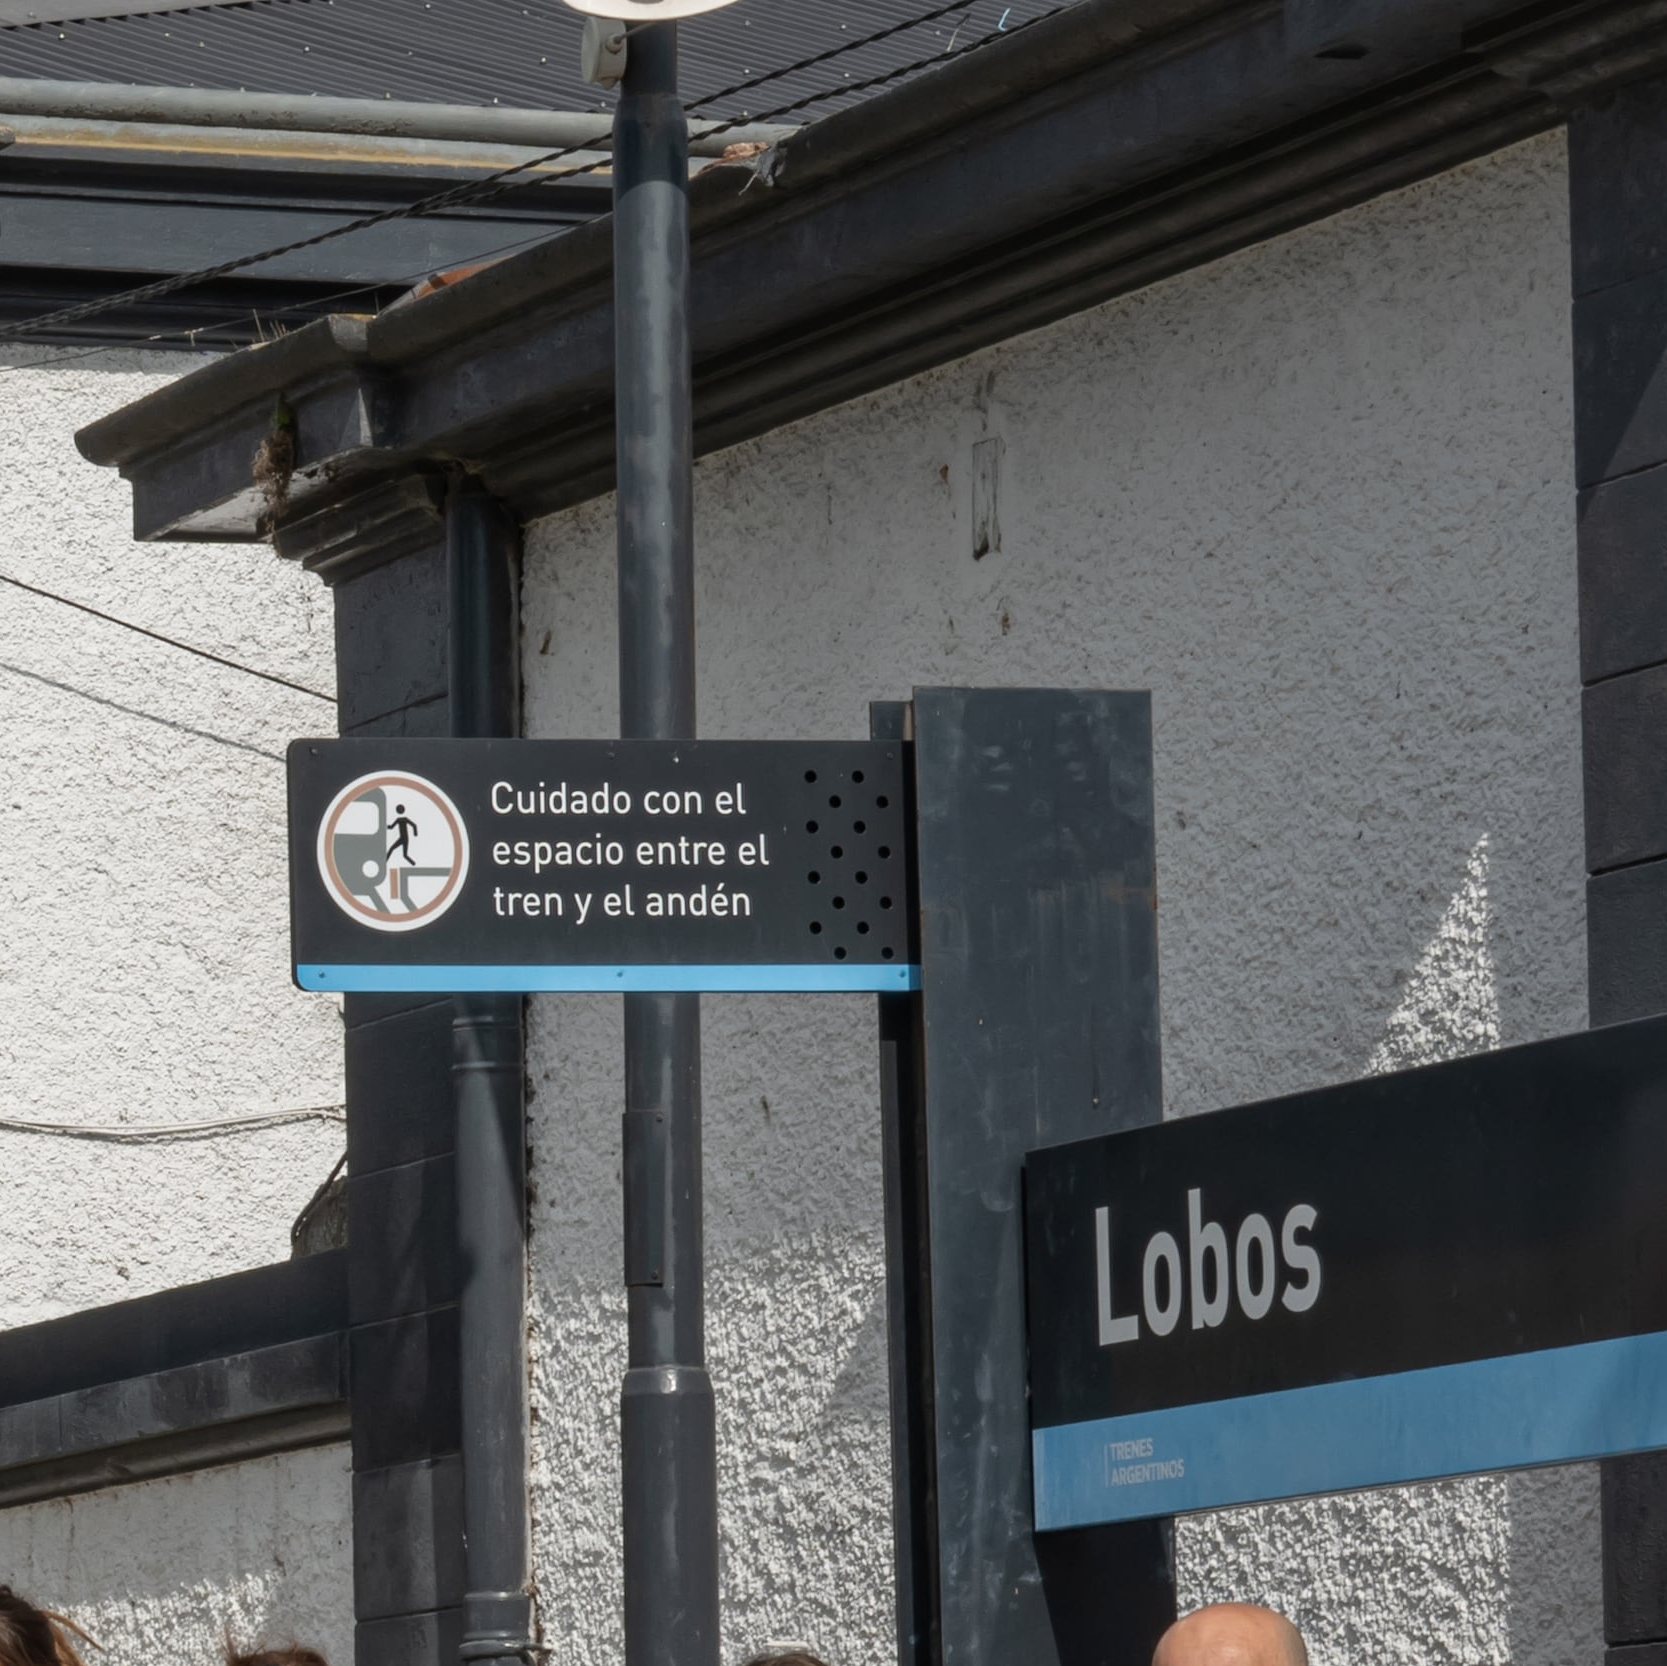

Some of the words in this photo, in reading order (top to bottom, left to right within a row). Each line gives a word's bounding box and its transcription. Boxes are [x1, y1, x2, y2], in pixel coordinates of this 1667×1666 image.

[490, 780, 632, 816] Cuidado
[643, 789, 703, 816] con
[715, 781, 747, 815] el
[492, 832, 625, 874] espacio
[635, 836, 727, 866] entre
[737, 833, 770, 866] el
[493, 886, 564, 917] tren
[574, 892, 593, 925] y
[603, 884, 636, 917] el
[645, 883, 752, 917] andén
[1094, 1187, 1323, 1347] Lobos
[1109, 1437, 1154, 1461] TRENES
[1110, 1458, 1186, 1486] ARGENTINOS
